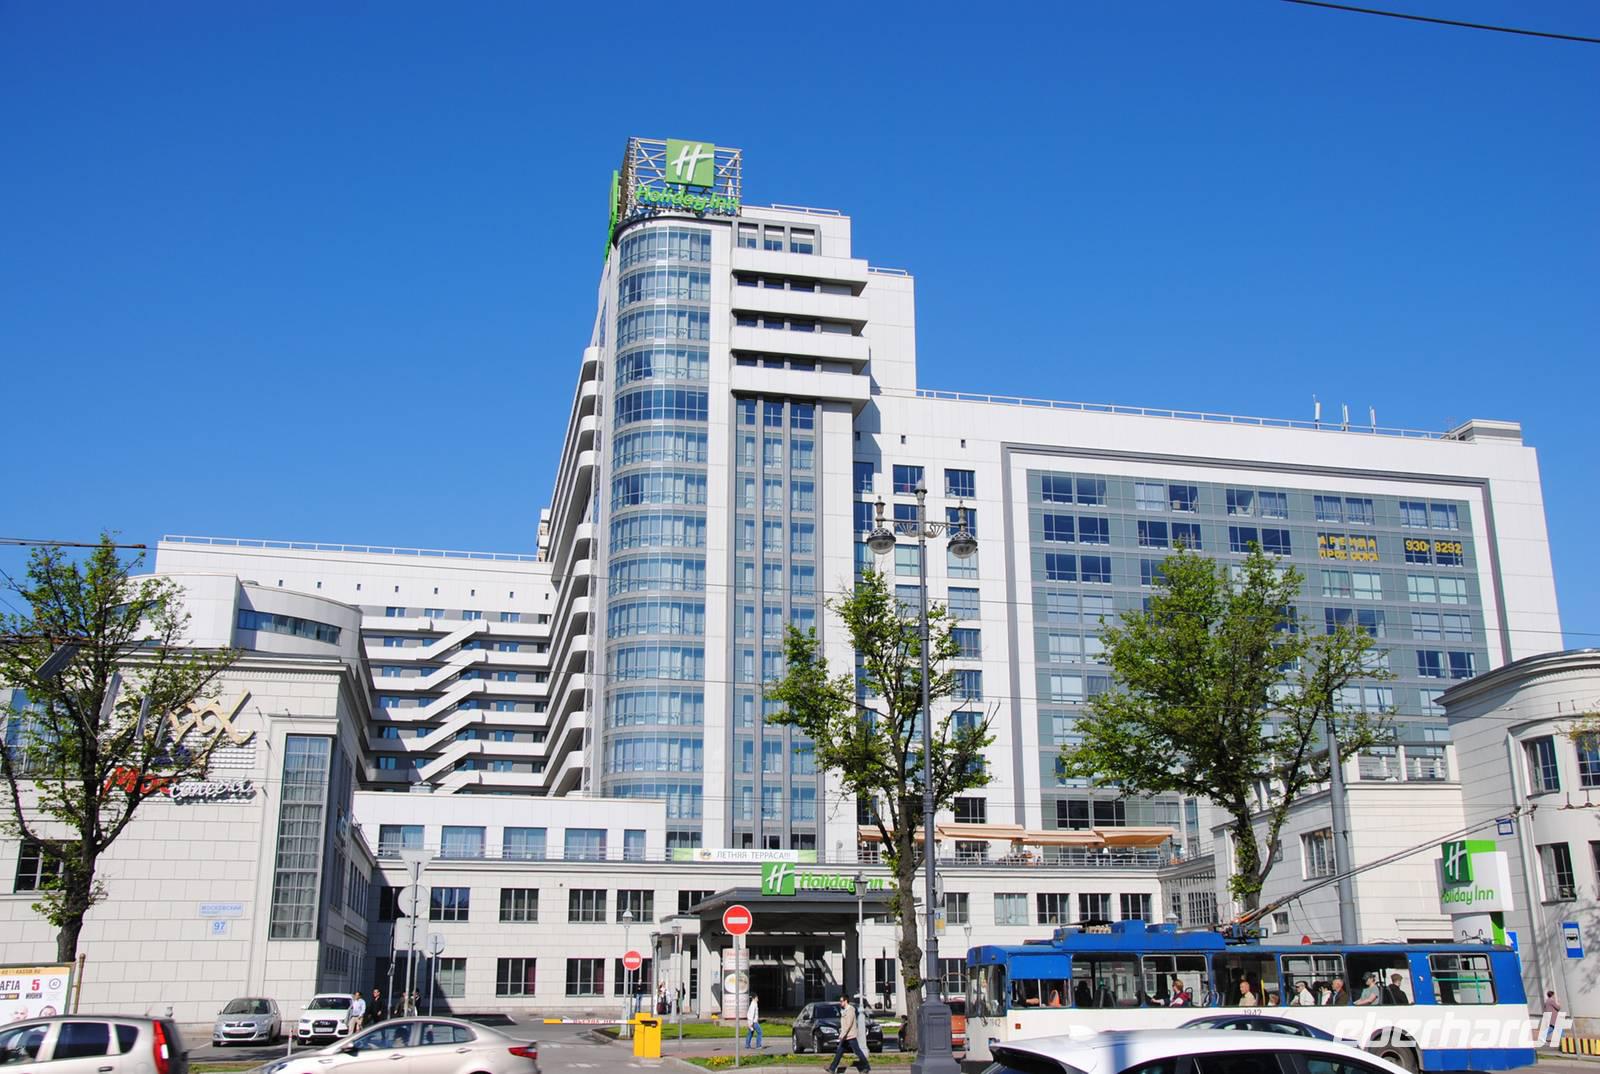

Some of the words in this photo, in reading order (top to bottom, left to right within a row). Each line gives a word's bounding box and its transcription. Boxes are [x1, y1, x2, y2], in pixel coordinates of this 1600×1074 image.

[635, 184, 707, 210] Holiday
[709, 192, 738, 209] Inn
[716, 851, 747, 859] ЛЕТНЯЯ
[800, 872, 856, 892] Holiday
[1441, 887, 1473, 905] Holiday
[1475, 885, 1494, 900] Inn
[214, 921, 225, 930] 97
[31, 979, 40, 991] 5
